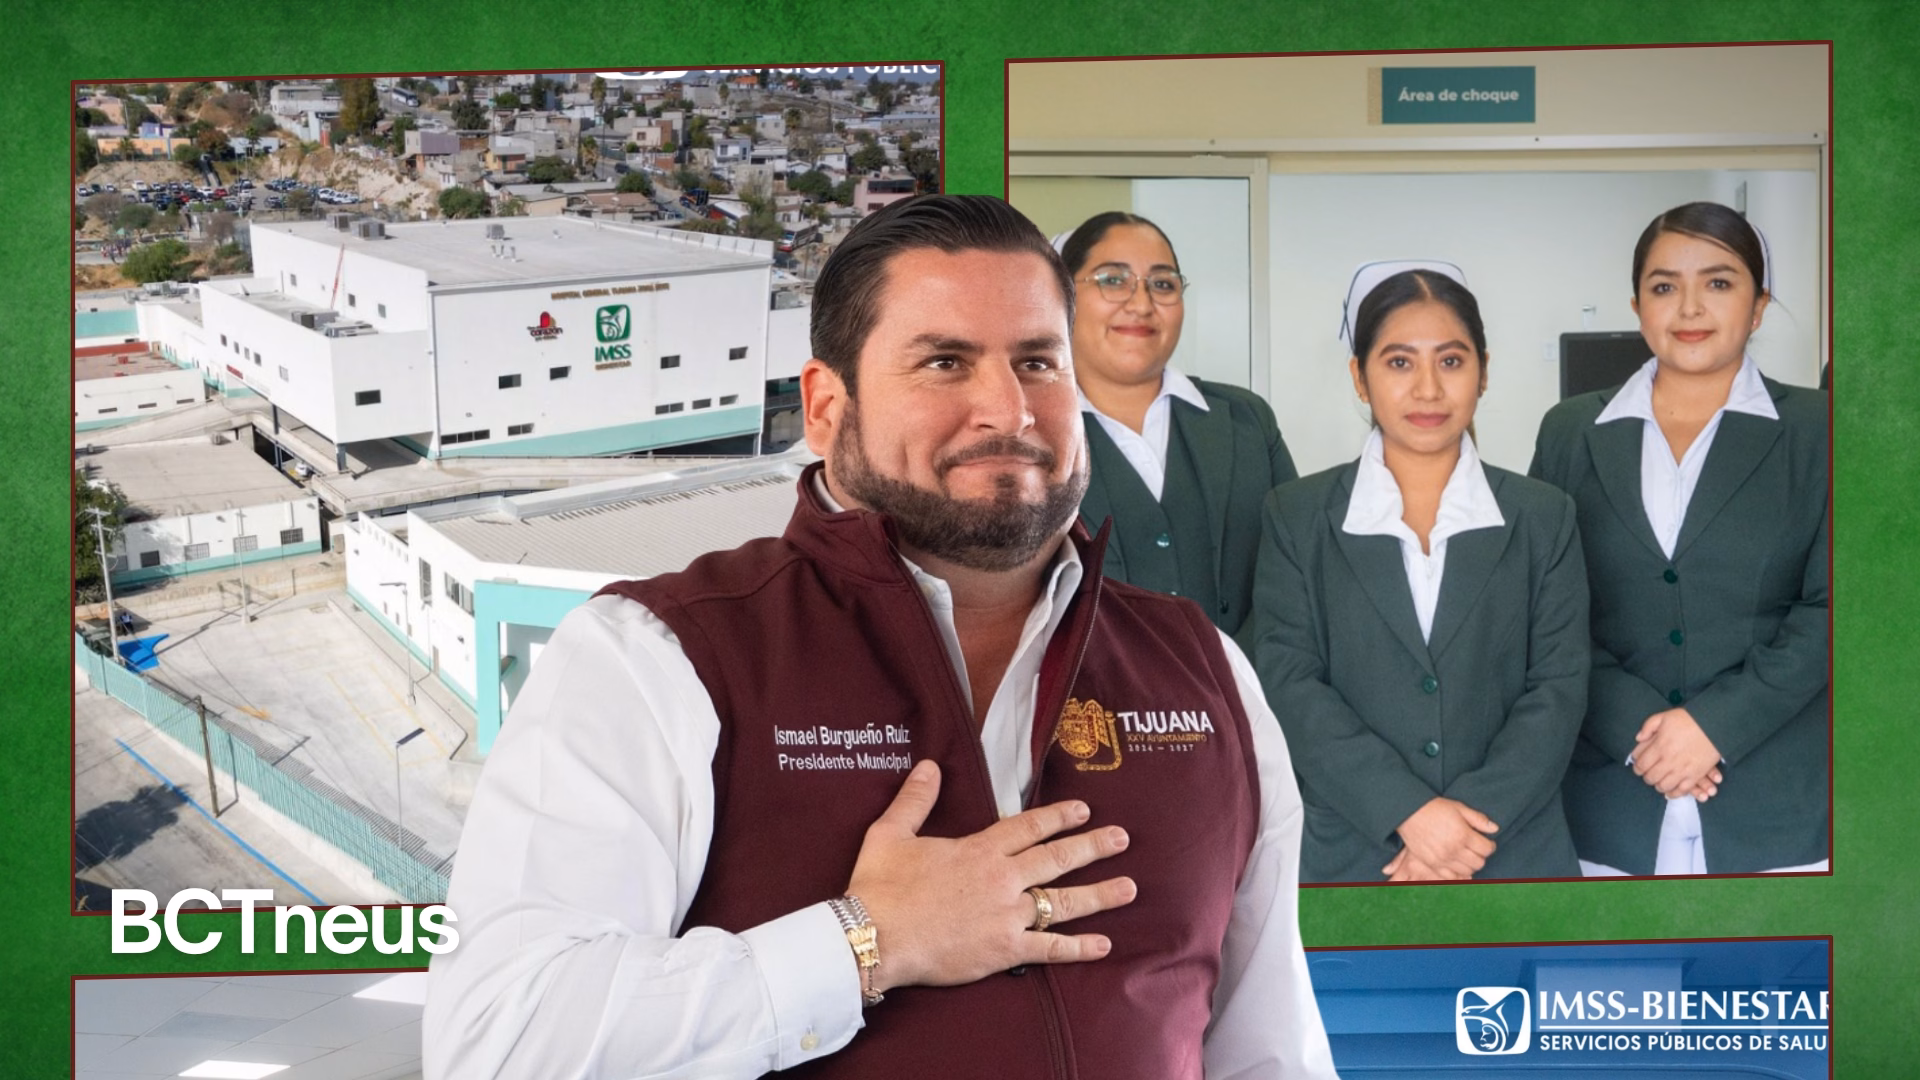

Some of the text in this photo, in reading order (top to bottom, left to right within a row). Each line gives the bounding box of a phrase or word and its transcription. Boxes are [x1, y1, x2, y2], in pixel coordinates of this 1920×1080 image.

[1398, 87, 1519, 104] Área de choque
[594, 343, 632, 362] IMSS
[1117, 711, 1215, 734] TIJUANA
[774, 722, 911, 750] Ismael Burgueño Ruiz
[1127, 733, 1208, 743] XXV AYUNTAMIENTO
[778, 751, 912, 774] Presidente Municipal
